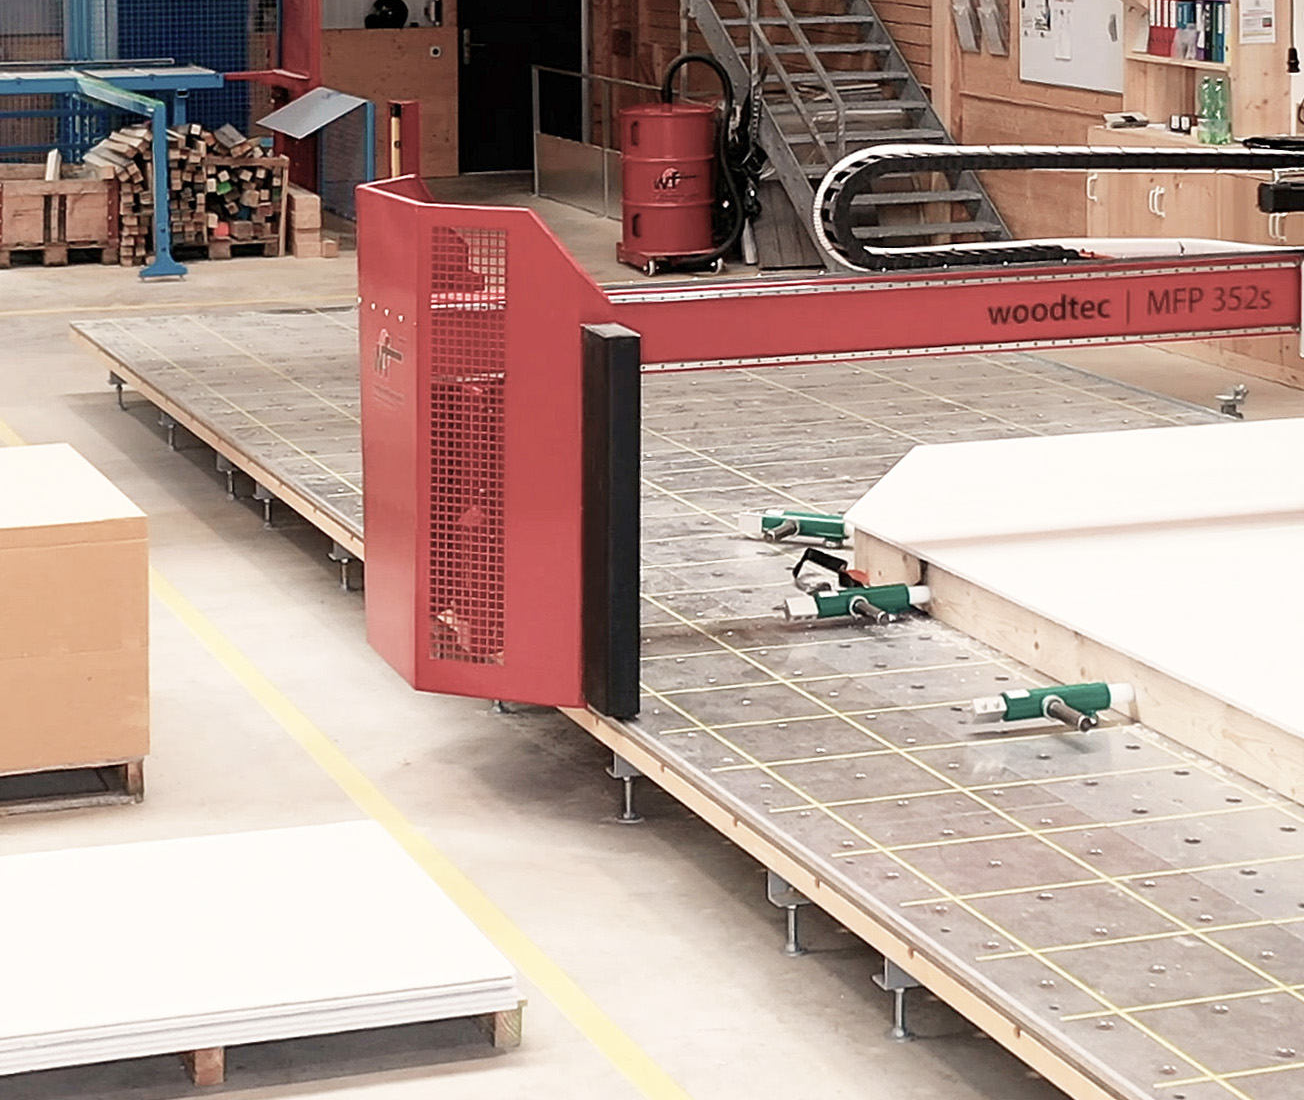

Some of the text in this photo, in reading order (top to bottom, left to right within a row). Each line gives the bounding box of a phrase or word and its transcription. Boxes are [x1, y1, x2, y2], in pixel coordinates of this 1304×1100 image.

[988, 284, 1273, 325] woodtec MFP 352s
